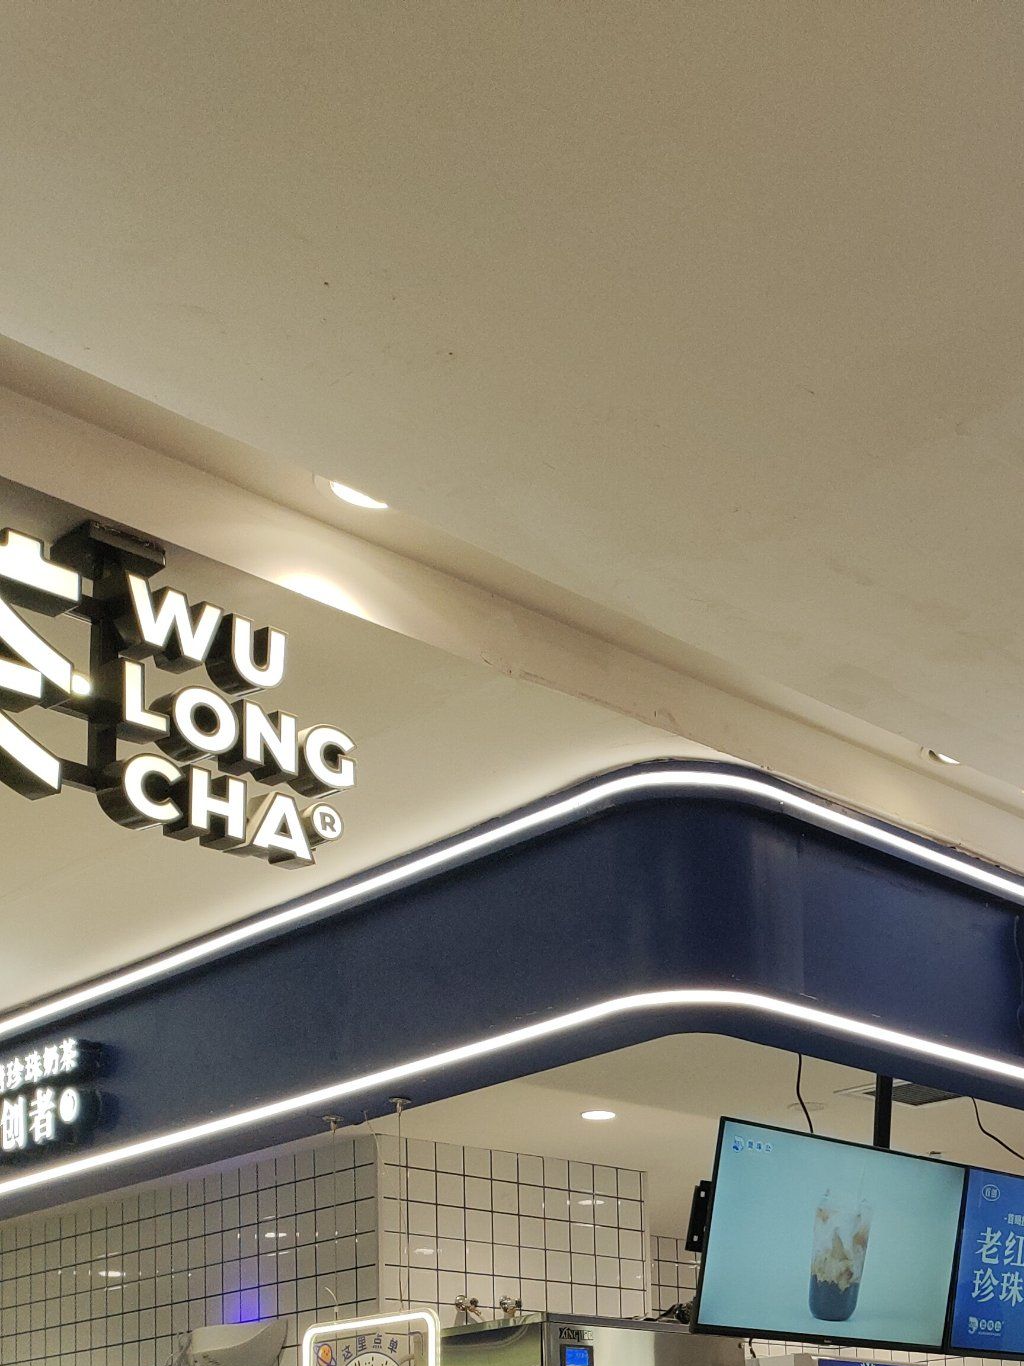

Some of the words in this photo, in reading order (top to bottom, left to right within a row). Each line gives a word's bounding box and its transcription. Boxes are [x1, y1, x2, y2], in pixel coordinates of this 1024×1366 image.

[127, 570, 288, 688] WU
[123, 659, 357, 789] LONG
[0, 1038, 79, 1093] 珍珠奶茶
[341, 1333, 399, 1361] 这里点单
